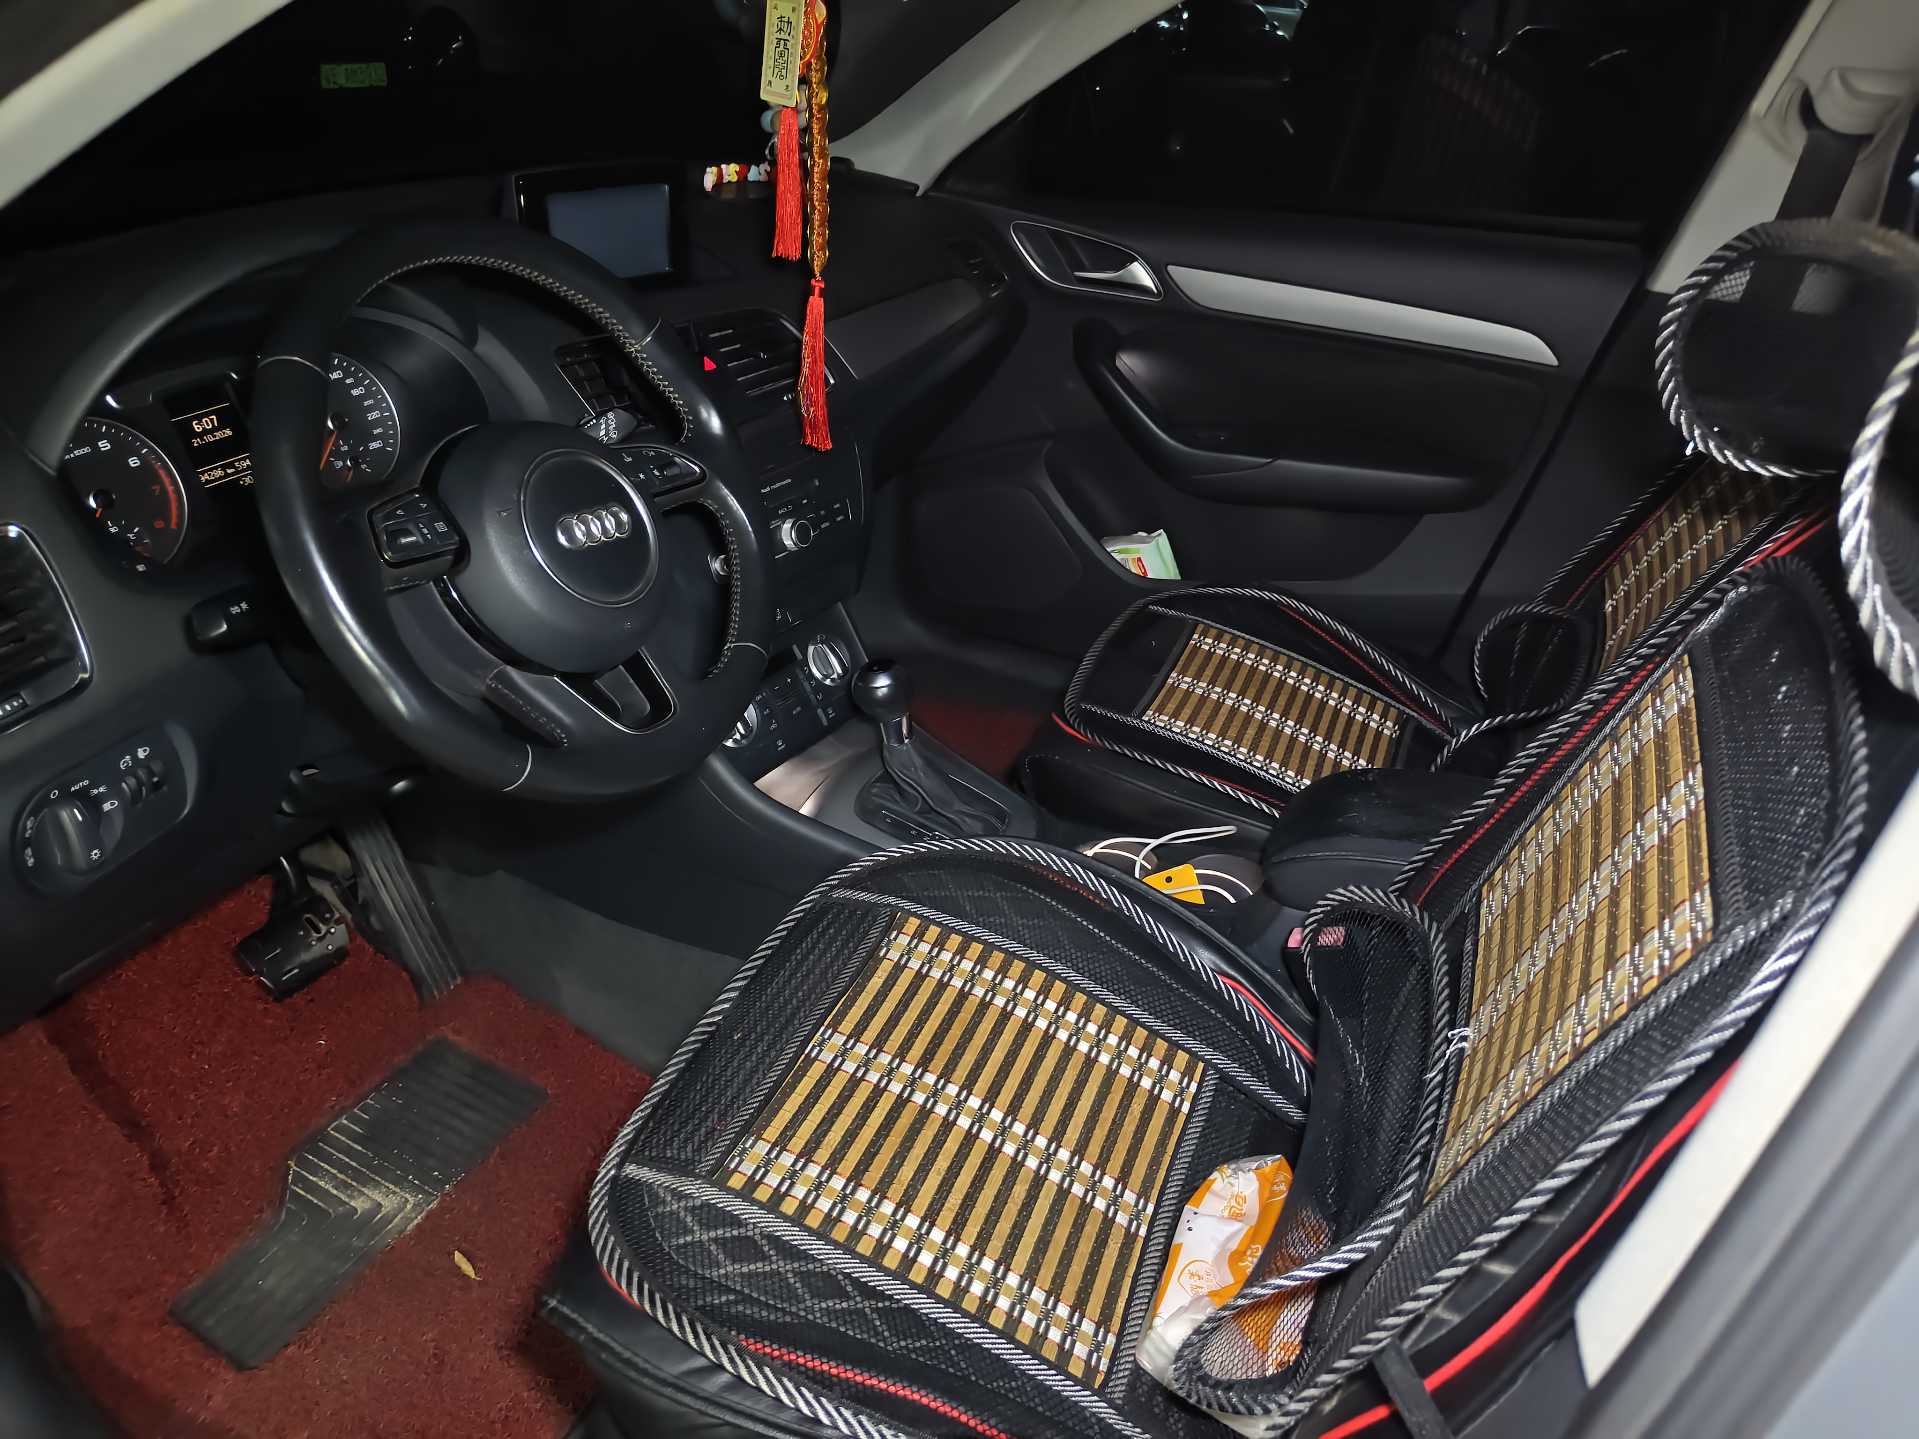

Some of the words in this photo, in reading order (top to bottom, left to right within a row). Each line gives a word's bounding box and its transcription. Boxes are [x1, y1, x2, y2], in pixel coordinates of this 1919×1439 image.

[329, 370, 343, 380] 140
[351, 386, 365, 396] 180
[367, 411, 380, 420] 220
[192, 415, 218, 432] 6:07
[97, 439, 111, 451] 5
[368, 440, 383, 450] 260
[127, 456, 141, 468] 6
[151, 484, 161, 495] 7
[71, 780, 88, 792] AUTO
